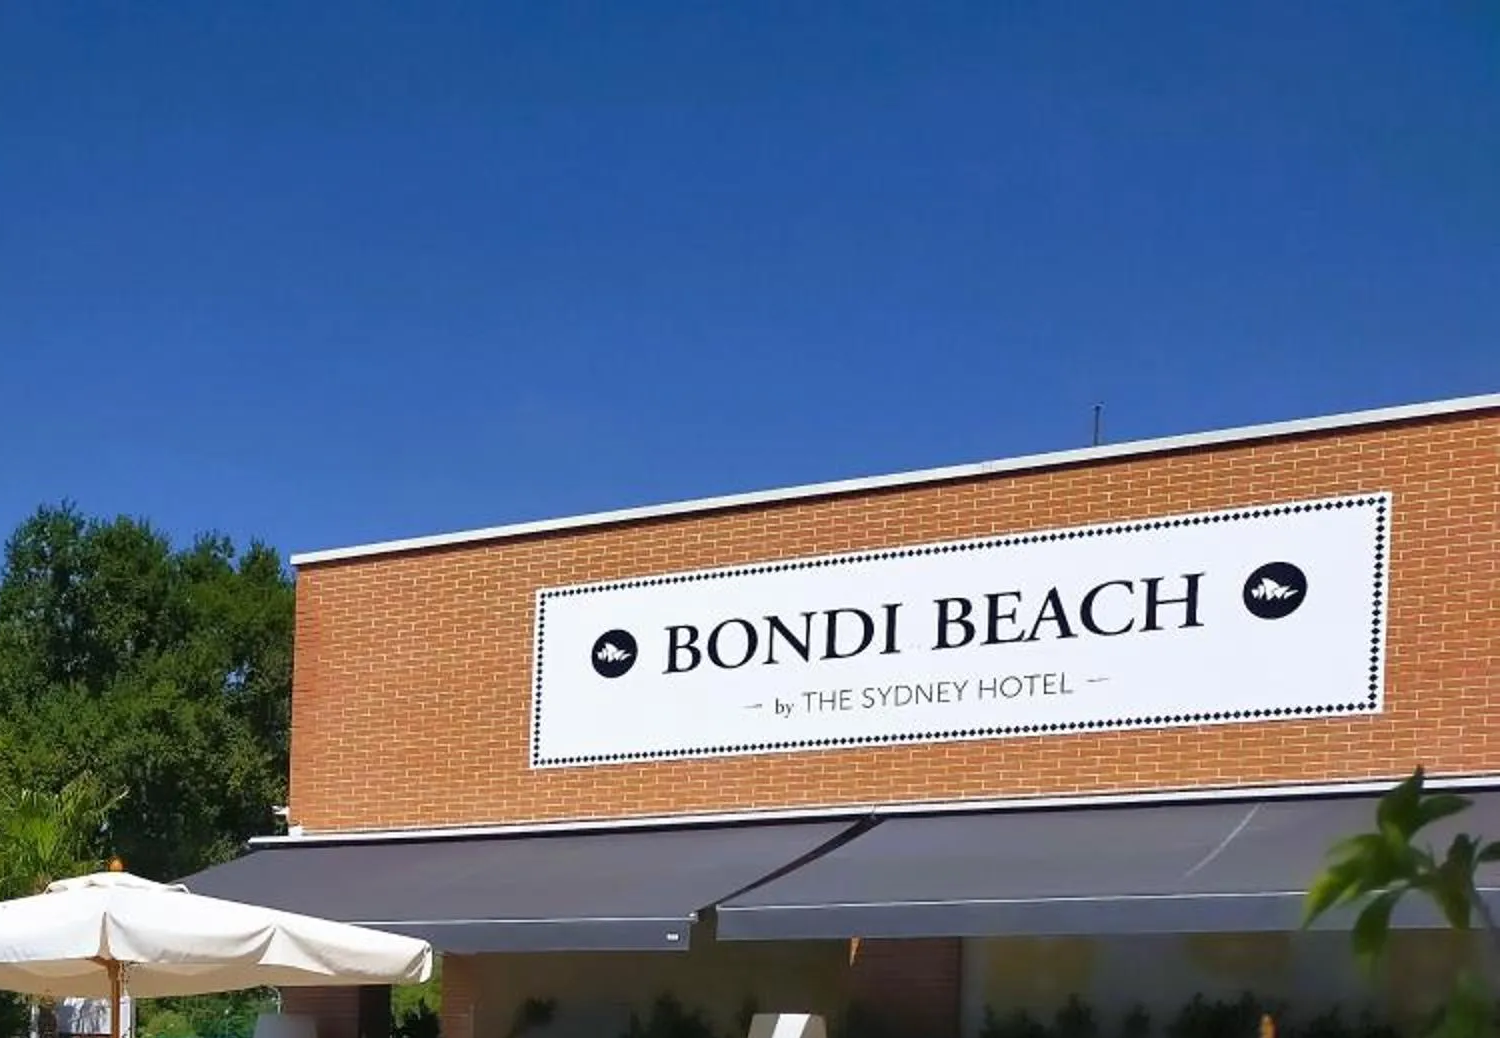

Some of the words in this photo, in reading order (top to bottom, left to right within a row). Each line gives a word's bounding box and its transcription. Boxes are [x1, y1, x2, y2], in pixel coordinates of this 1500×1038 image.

[662, 603, 902, 674] BONDI
[932, 572, 1205, 650] BEACH
[775, 698, 794, 718] by
[802, 690, 853, 712] THE
[861, 681, 968, 708] SYDNEY
[978, 672, 1073, 699] HOTEL
